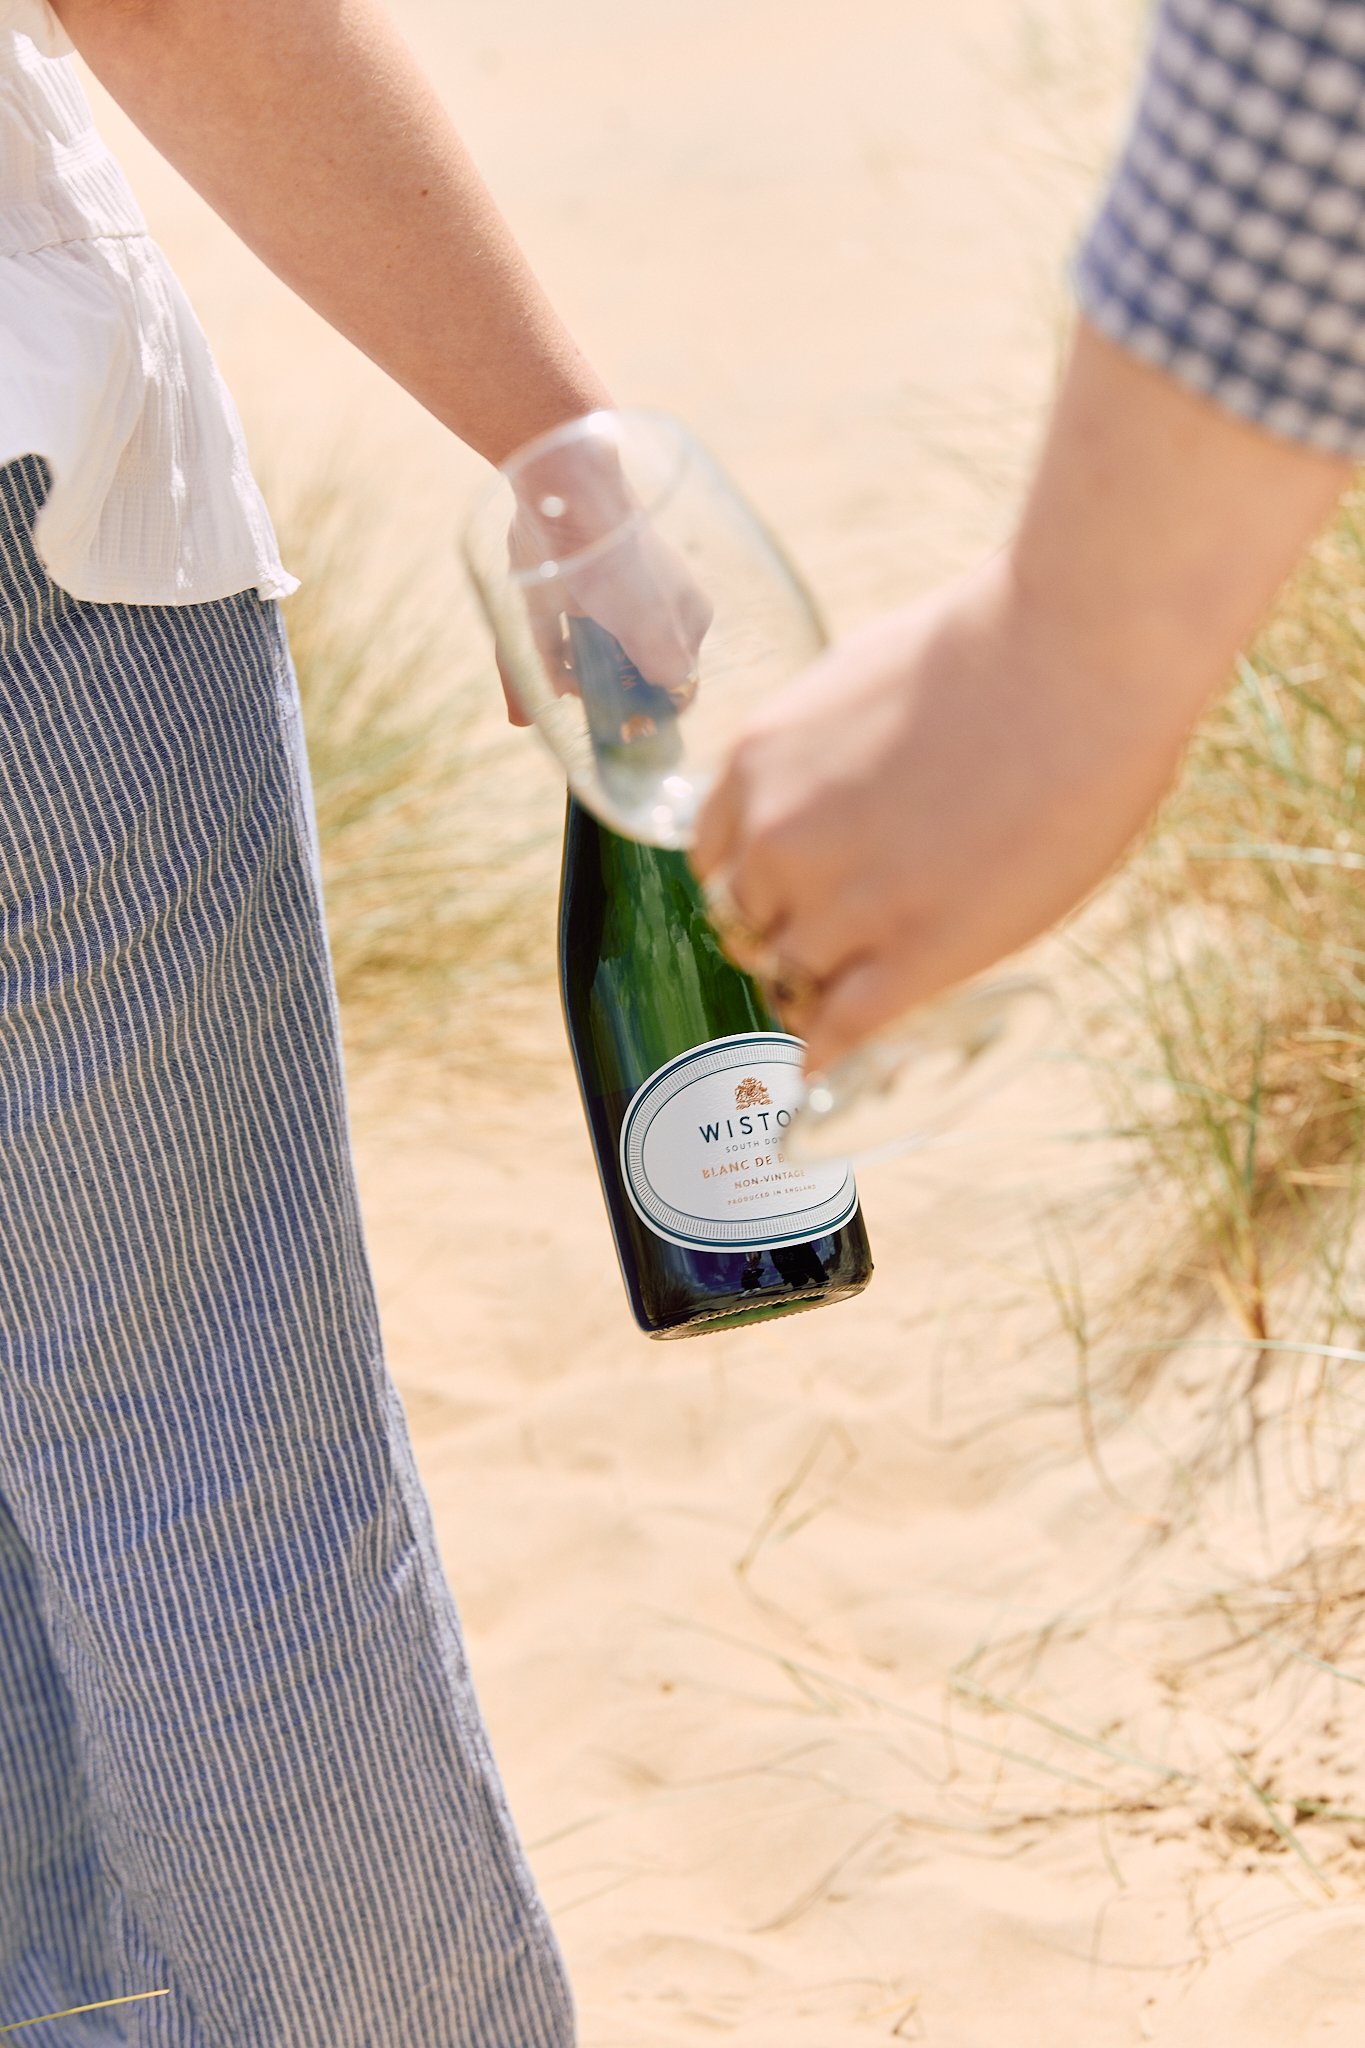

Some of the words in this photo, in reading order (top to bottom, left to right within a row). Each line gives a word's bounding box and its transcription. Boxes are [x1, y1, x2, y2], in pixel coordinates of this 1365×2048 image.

[698, 1108, 799, 1143] WISTO
[725, 1141, 760, 1153] SOUTH
[702, 1159, 750, 1179] BLANC
[755, 1155, 772, 1167] DE
[734, 1169, 806, 1189] NON-VINTAGE
[727, 1192, 770, 1205] PRODUCED
[784, 1184, 817, 1194] ENGLAND
